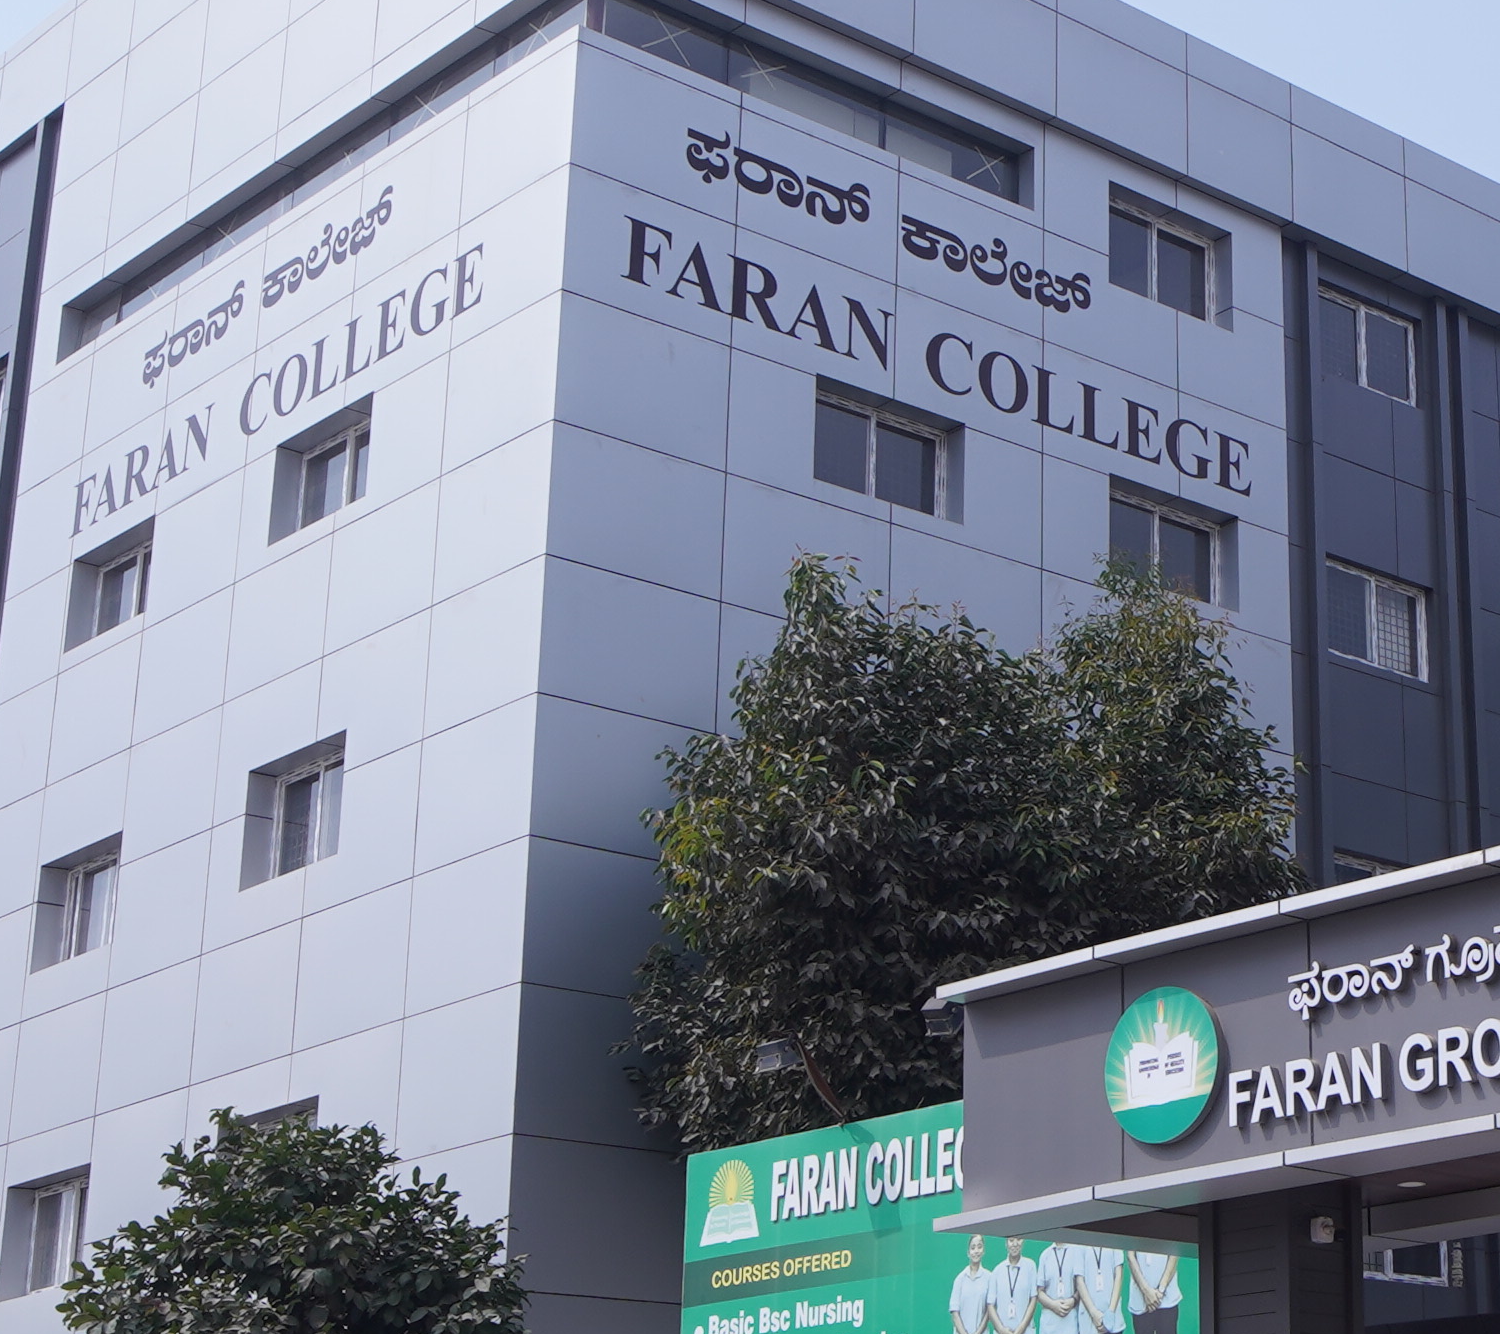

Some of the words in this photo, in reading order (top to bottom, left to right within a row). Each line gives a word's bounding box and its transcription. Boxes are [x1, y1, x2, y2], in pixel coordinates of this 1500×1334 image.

[687, 128, 870, 225] ಫರಾನ್
[902, 215, 1091, 312] ಕಾಲೇಜ್
[142, 279, 246, 389] ಫರಾನ್
[262, 185, 394, 309] ಕಾಲೇಜ್
[69, 403, 215, 538] FARAN
[239, 243, 485, 436] COLLEGE
[621, 215, 893, 370] FARAN
[926, 332, 1252, 496] COLLEGE
[1287, 944, 1414, 1021] ಫರಾನ್
[1228, 1042, 1382, 1126] FARAN
[770, 1146, 858, 1222] FARAN
[711, 1263, 780, 1290] COURSES
[782, 1249, 852, 1278] OFFERED
[758, 1308, 790, 1334] Bsc
[795, 1296, 864, 1330] Nursing
